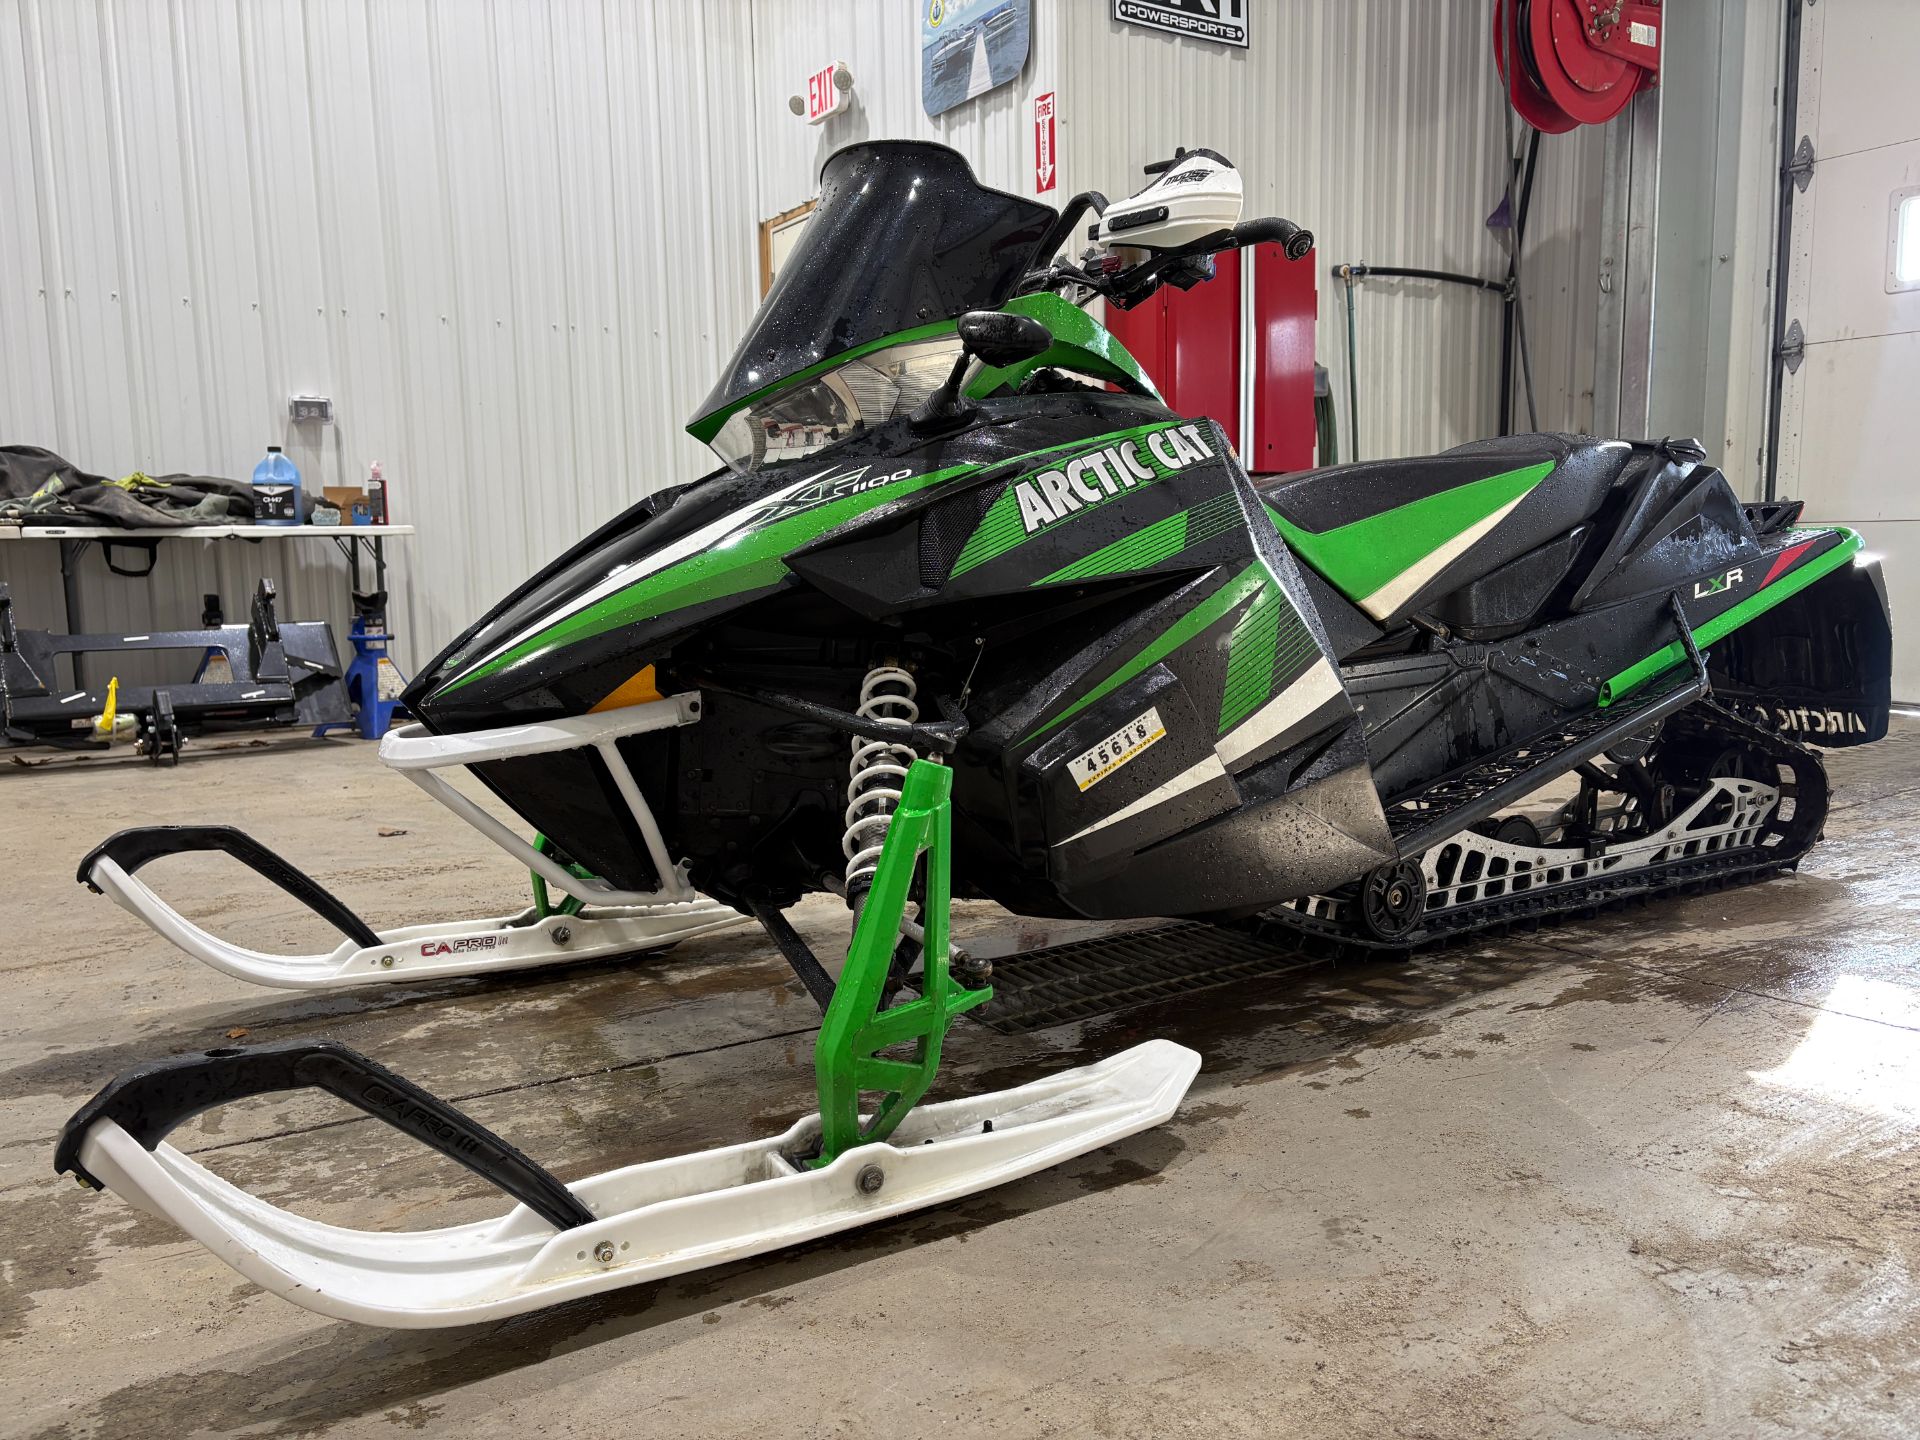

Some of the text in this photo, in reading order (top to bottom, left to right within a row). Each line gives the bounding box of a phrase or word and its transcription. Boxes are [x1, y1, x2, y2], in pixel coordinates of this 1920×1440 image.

[1127, 5, 1236, 38] POWERSPORTS
[808, 65, 834, 118] EXIT
[1037, 102, 1051, 118] FIRE
[1162, 169, 1214, 186] MOOSE
[853, 468, 914, 494] 1100
[1015, 424, 1216, 533] ARCTIC CAT
[1694, 568, 1743, 599] LXR
[1075, 715, 1147, 765] NEW HAMPSHIRE
[1087, 724, 1147, 772] 45618
